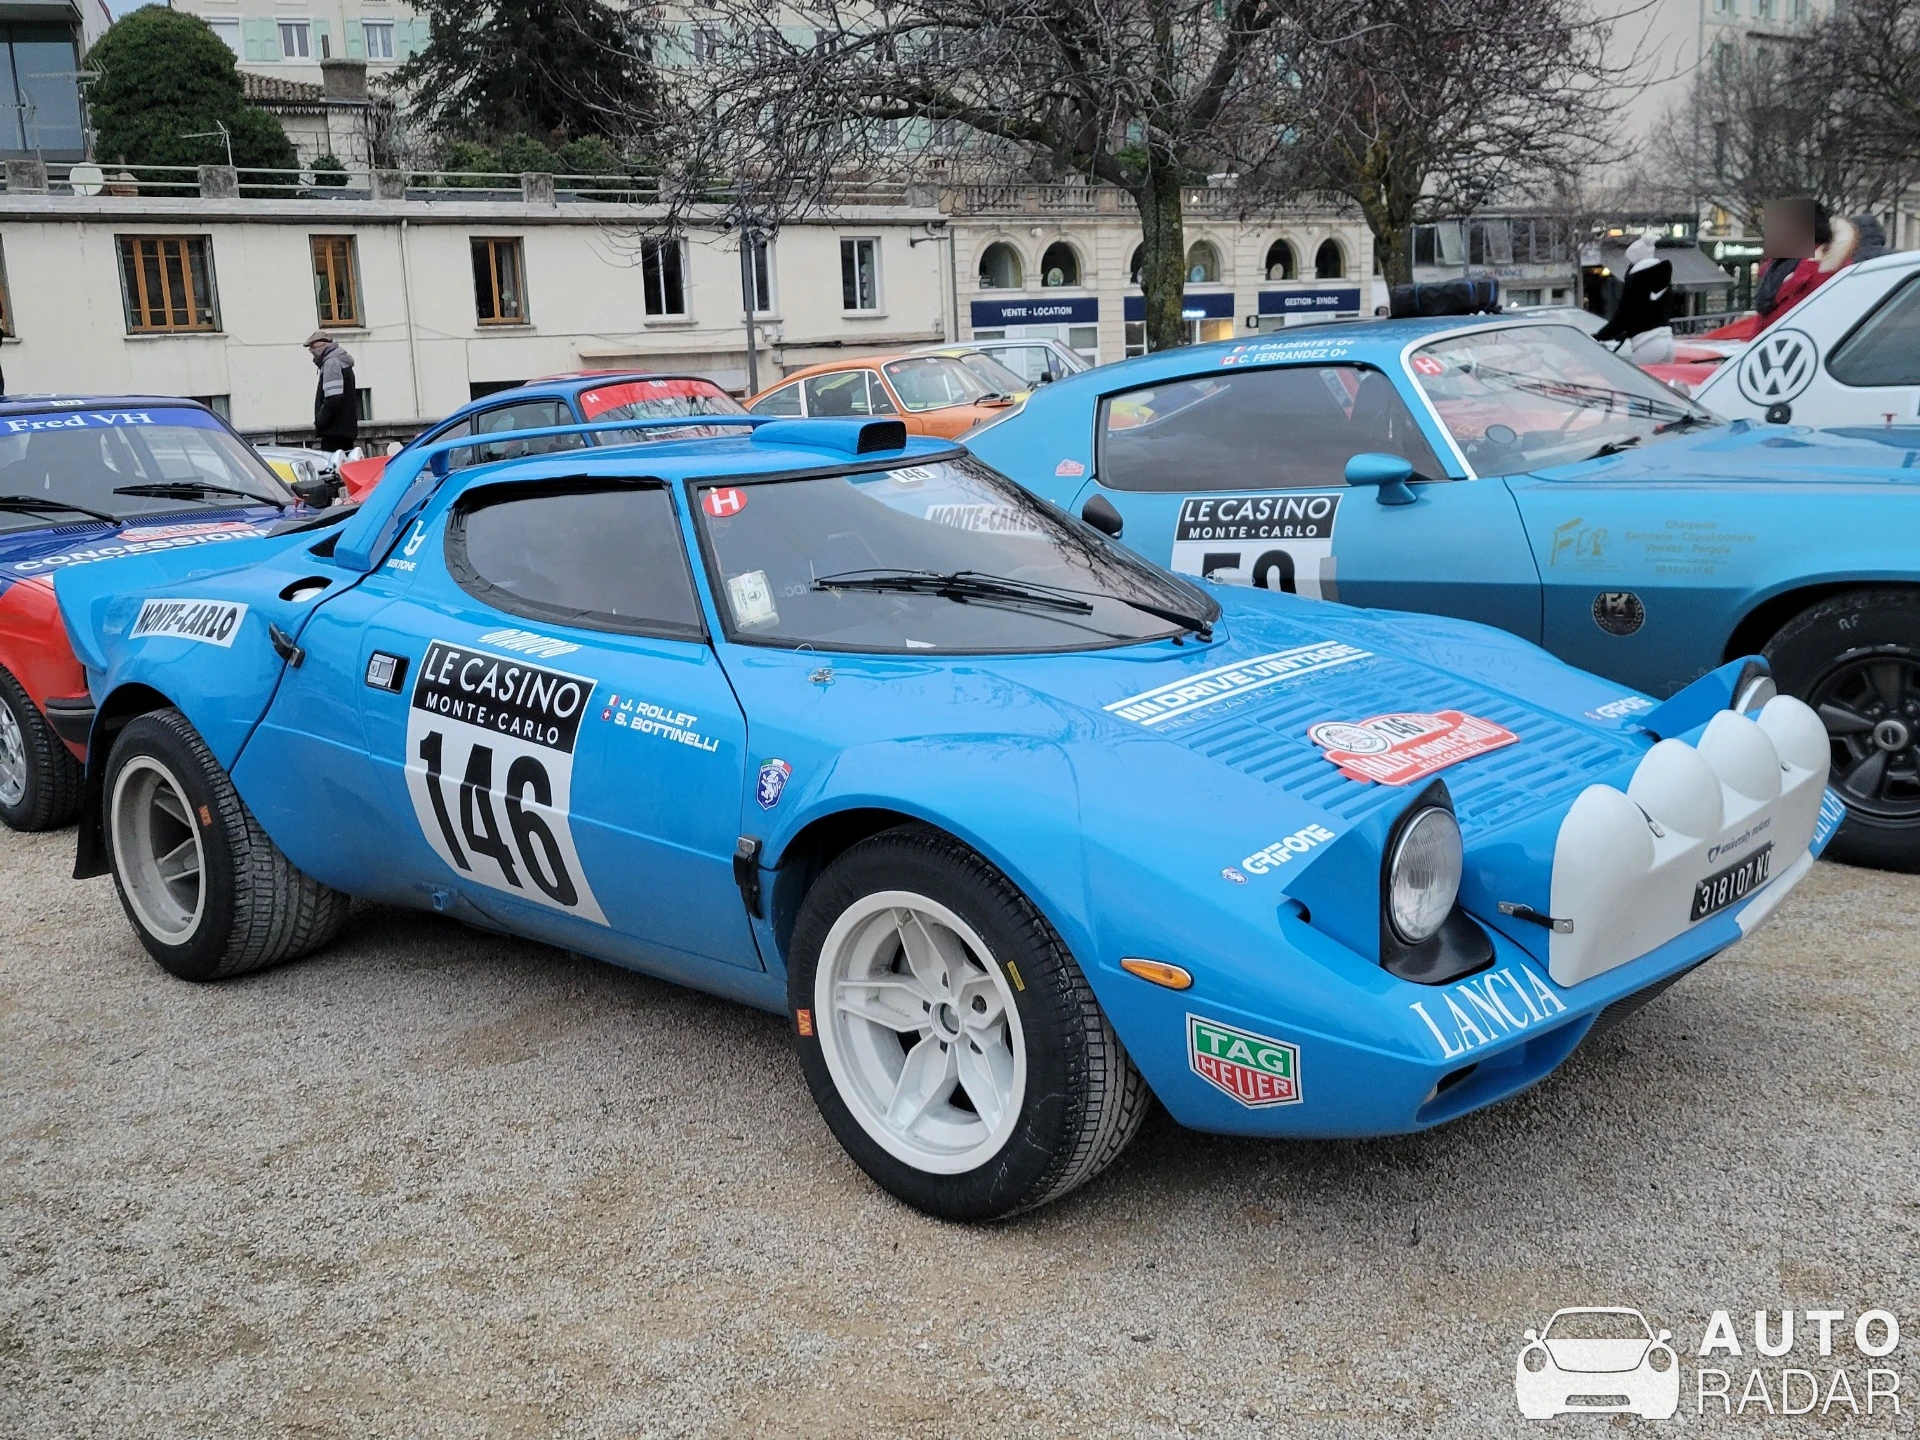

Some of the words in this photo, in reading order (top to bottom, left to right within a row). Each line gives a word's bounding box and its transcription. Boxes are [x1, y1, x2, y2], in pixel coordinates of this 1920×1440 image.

[1001, 307, 1028, 317] VENTE
[1033, 306, 1073, 316] LOCATION
[1284, 297, 1312, 306] GESTION
[1316, 296, 1340, 305] SYNDIC
[1238, 354, 1250, 364] C.
[1252, 348, 1329, 363] FERRANDEZ
[1259, 339, 1335, 351] CALDENTEY
[1416, 357, 1441, 375] H
[586, 393, 600, 404] H
[4, 414, 89, 433] Fred
[89, 412, 156, 426] VH
[892, 468, 930, 481] 146
[710, 490, 741, 515] H
[1184, 500, 1215, 522] LE
[1217, 497, 1332, 521] CASINO
[386, 558, 417, 572] BERTONE
[134, 602, 238, 642] MONTE-CARLO
[424, 647, 461, 686] LE
[459, 657, 581, 719] CASINO
[1158, 670, 1256, 710] DRIVE
[1241, 644, 1364, 678] VINTAGE
[620, 698, 634, 712] J.
[635, 701, 698, 728] ROLLET
[1155, 708, 1211, 734] FINE
[1215, 694, 1253, 714] CAR
[613, 711, 628, 727] S.
[630, 715, 720, 753] BOTTINELLI
[1372, 717, 1425, 739] 146
[1341, 747, 1423, 781] RALLYE
[1418, 741, 1488, 769] HISTORIQUE
[419, 730, 579, 907] 146
[1241, 822, 1336, 875] GRIFONE
[1699, 862, 1753, 914] 318107
[799, 1010, 813, 1035] W7
[1408, 962, 1568, 1060] LANCIA
[1200, 1028, 1285, 1074] TAG
[1200, 1056, 1289, 1100] HEUER
